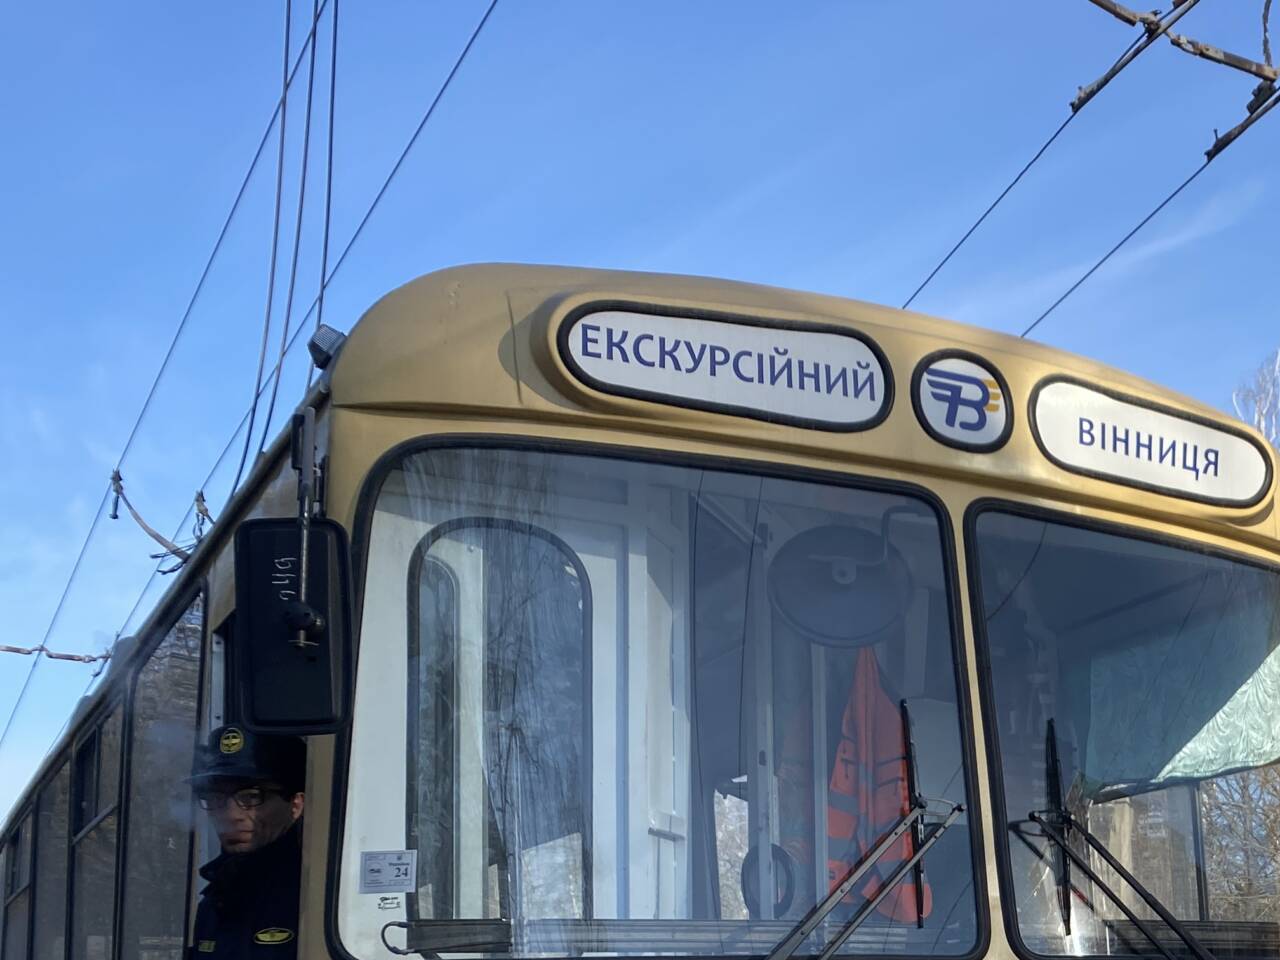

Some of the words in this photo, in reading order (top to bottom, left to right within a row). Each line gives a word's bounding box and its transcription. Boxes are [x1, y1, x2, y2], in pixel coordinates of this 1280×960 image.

[580, 323, 877, 403] ЕКСКУРСІЙНИЙ
[1078, 416, 1220, 481] ВІННИЦЯ
[394, 866, 408, 878] 24
